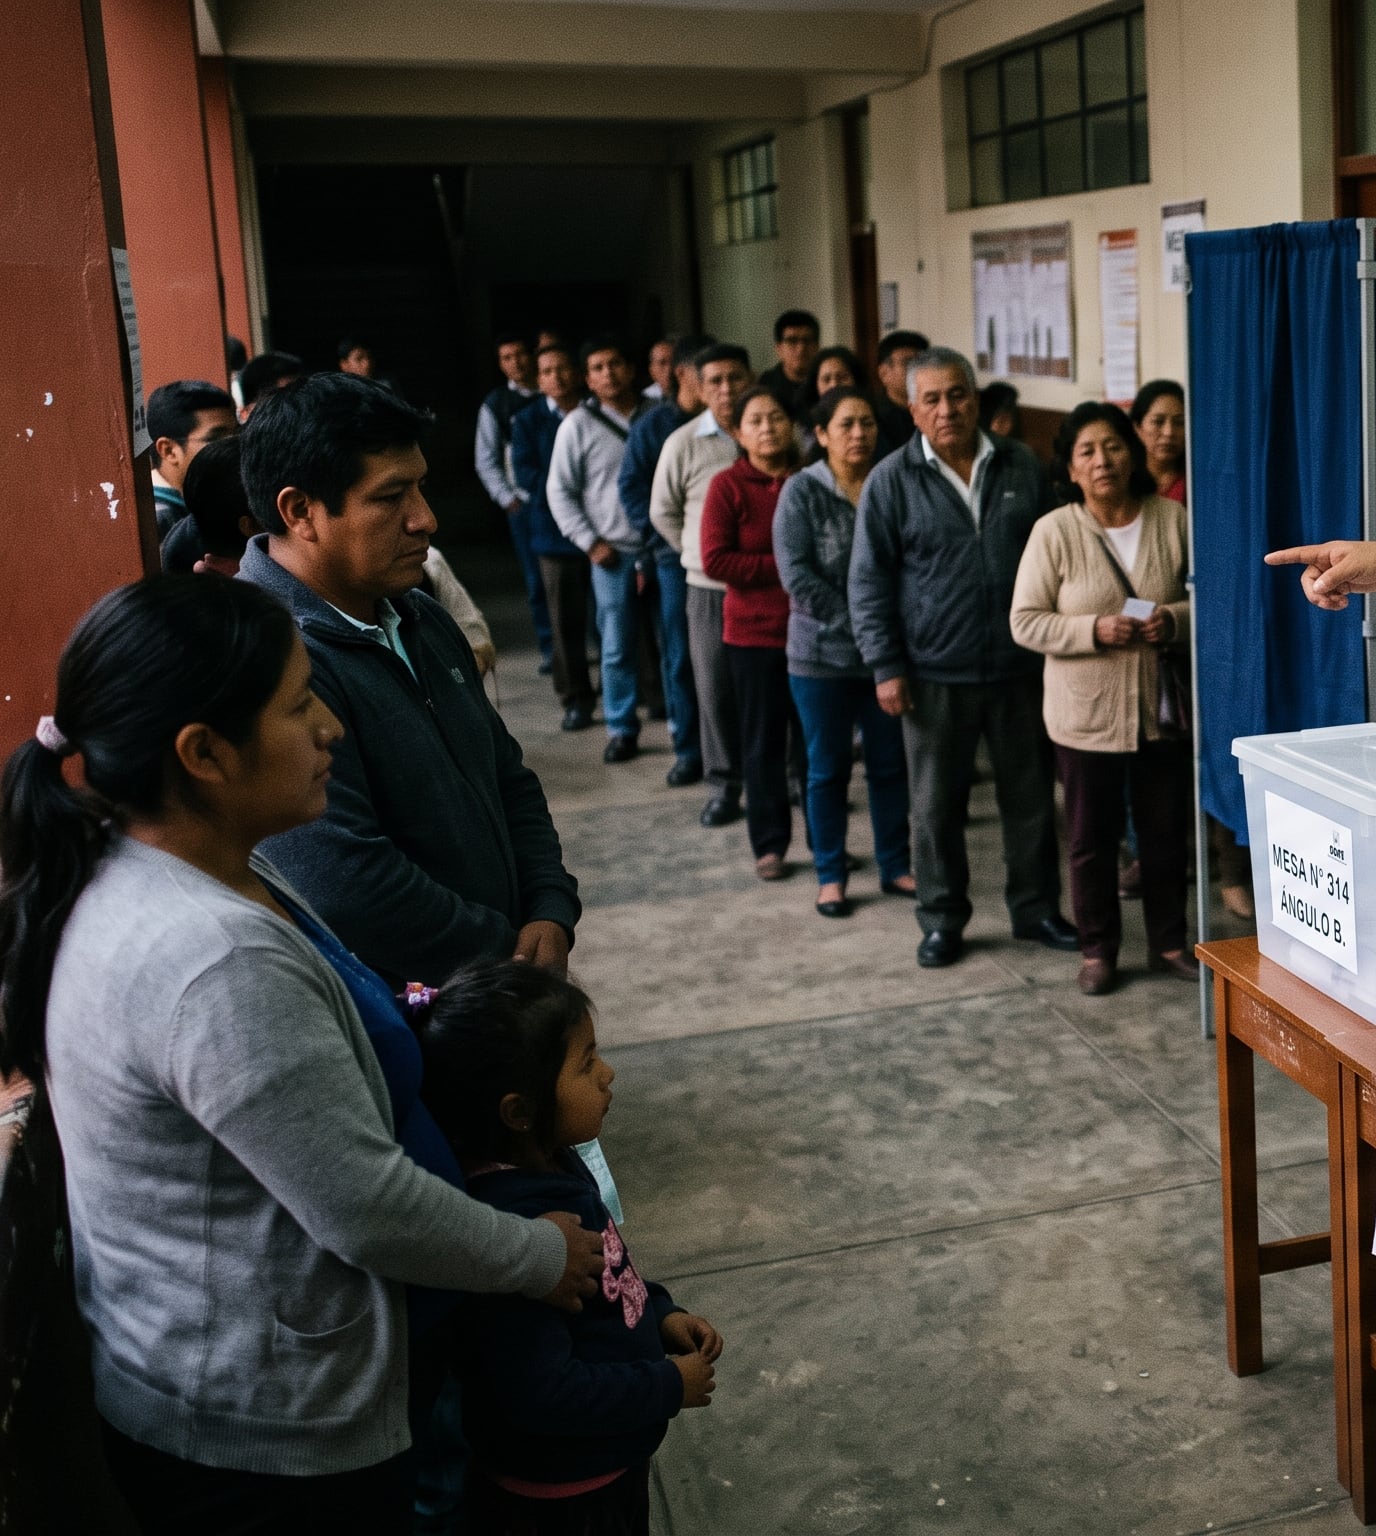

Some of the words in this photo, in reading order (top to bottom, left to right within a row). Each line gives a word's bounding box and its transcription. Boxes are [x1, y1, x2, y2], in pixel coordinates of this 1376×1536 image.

[1273, 844, 1307, 882] MESA
[1327, 872, 1350, 905] 314
[1281, 885, 1330, 937] ÁNGULO
[1334, 918, 1346, 947] B.
